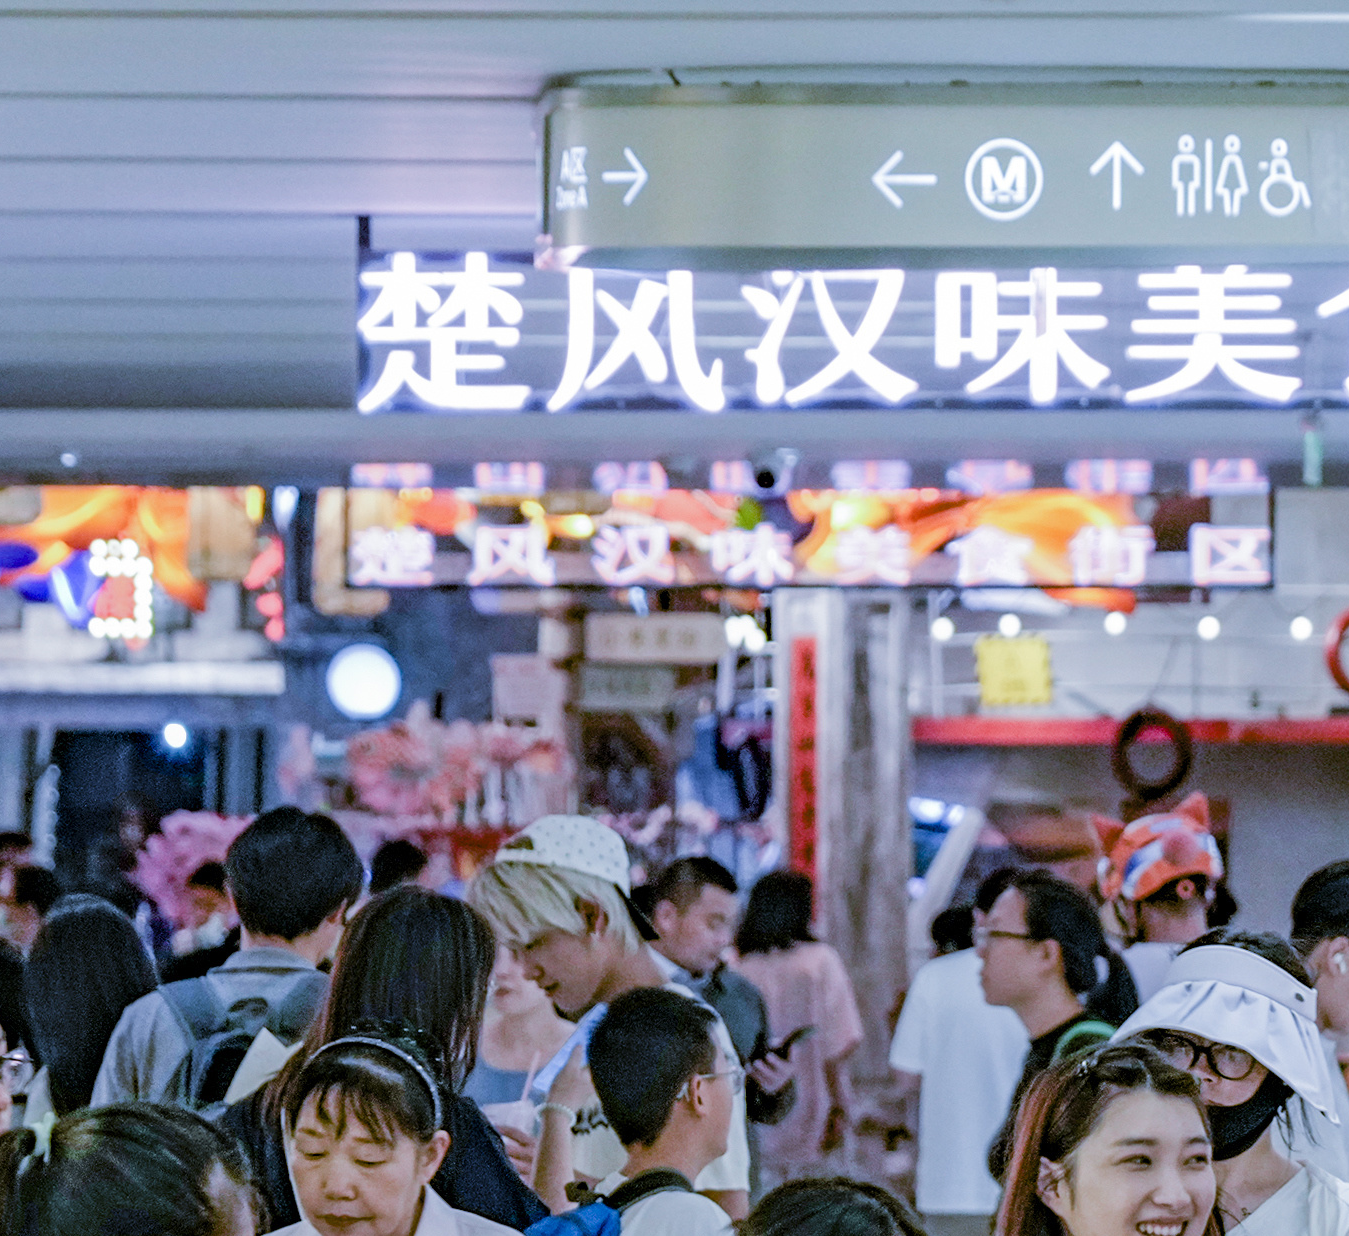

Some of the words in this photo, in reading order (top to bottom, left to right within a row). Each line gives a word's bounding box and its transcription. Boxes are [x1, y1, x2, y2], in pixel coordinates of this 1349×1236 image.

[351, 524, 1270, 587] 楚风汉味美食街区
